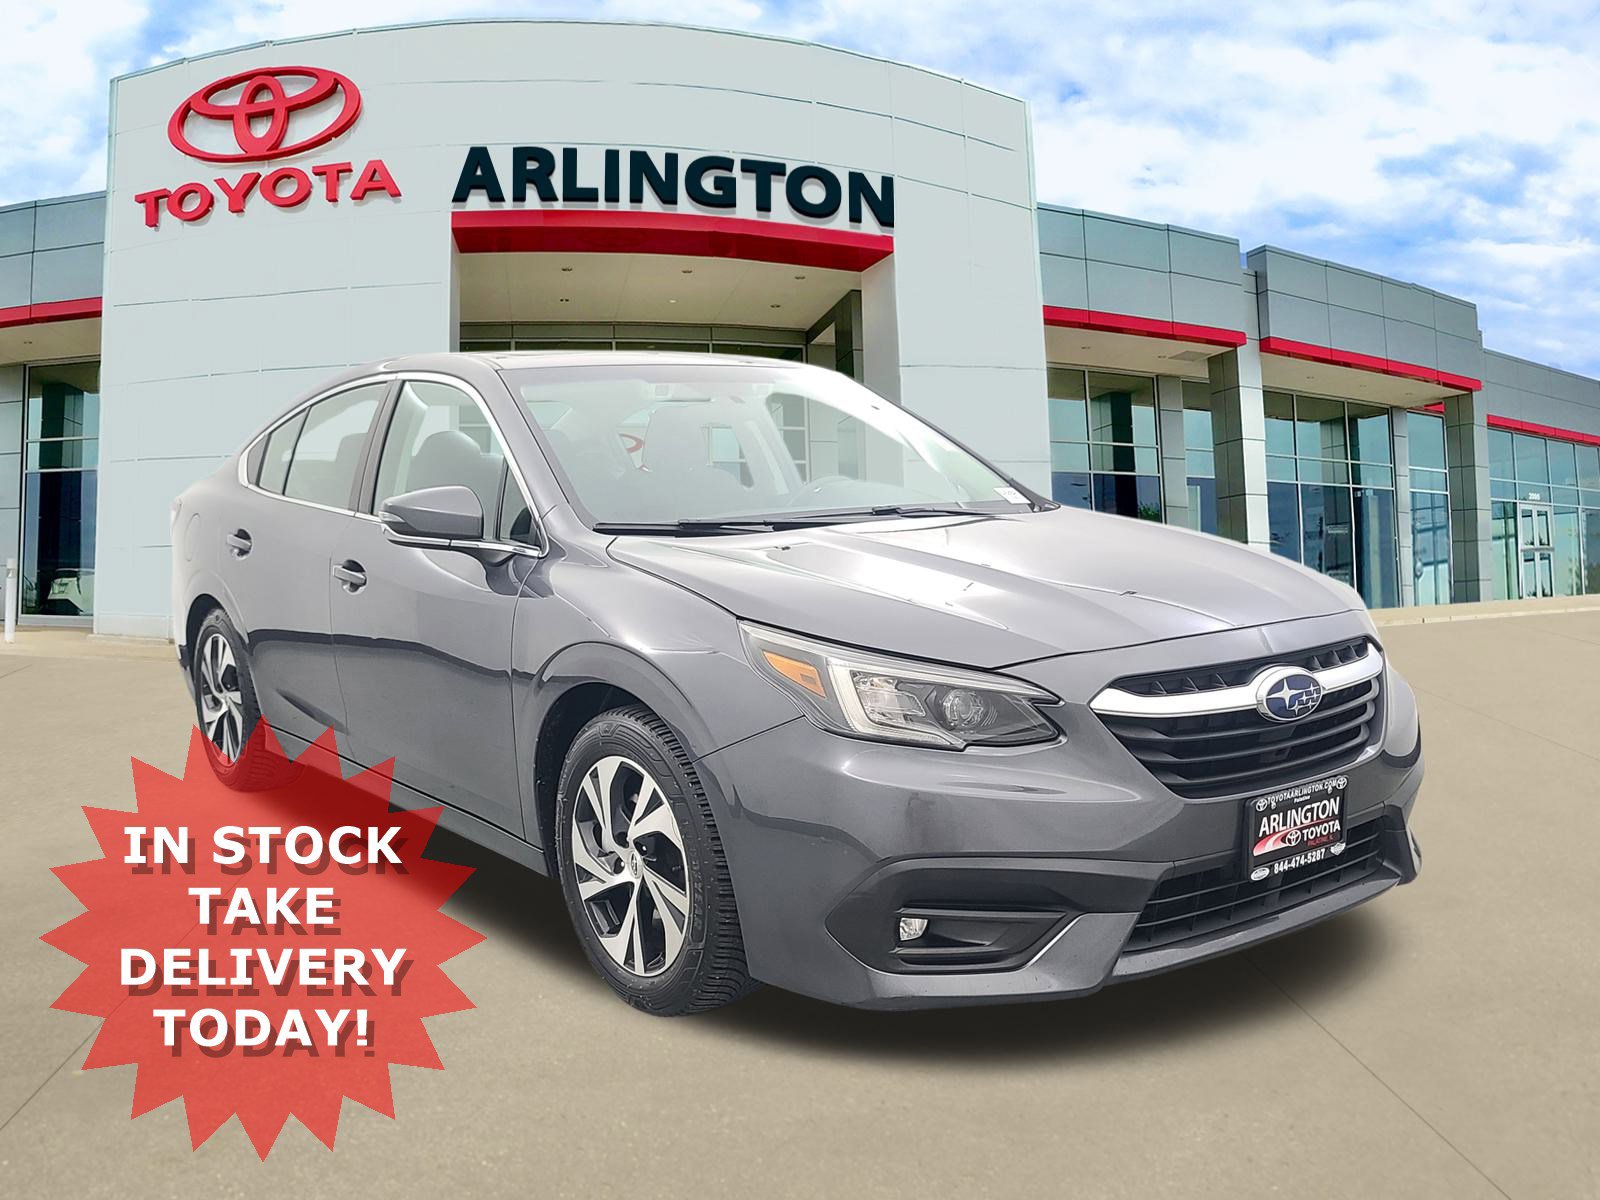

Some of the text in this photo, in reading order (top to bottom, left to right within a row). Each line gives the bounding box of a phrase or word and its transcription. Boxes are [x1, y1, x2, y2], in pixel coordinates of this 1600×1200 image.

[134, 160, 401, 227] TOYOTA
[451, 146, 894, 228] ARLINGTON
[1267, 780, 1337, 805] TOYOTAARLINGTON.COM
[1259, 797, 1340, 837] ARLINGTON
[1302, 820, 1341, 841] TOYOTA
[1273, 848, 1325, 874] 844-474-5287
